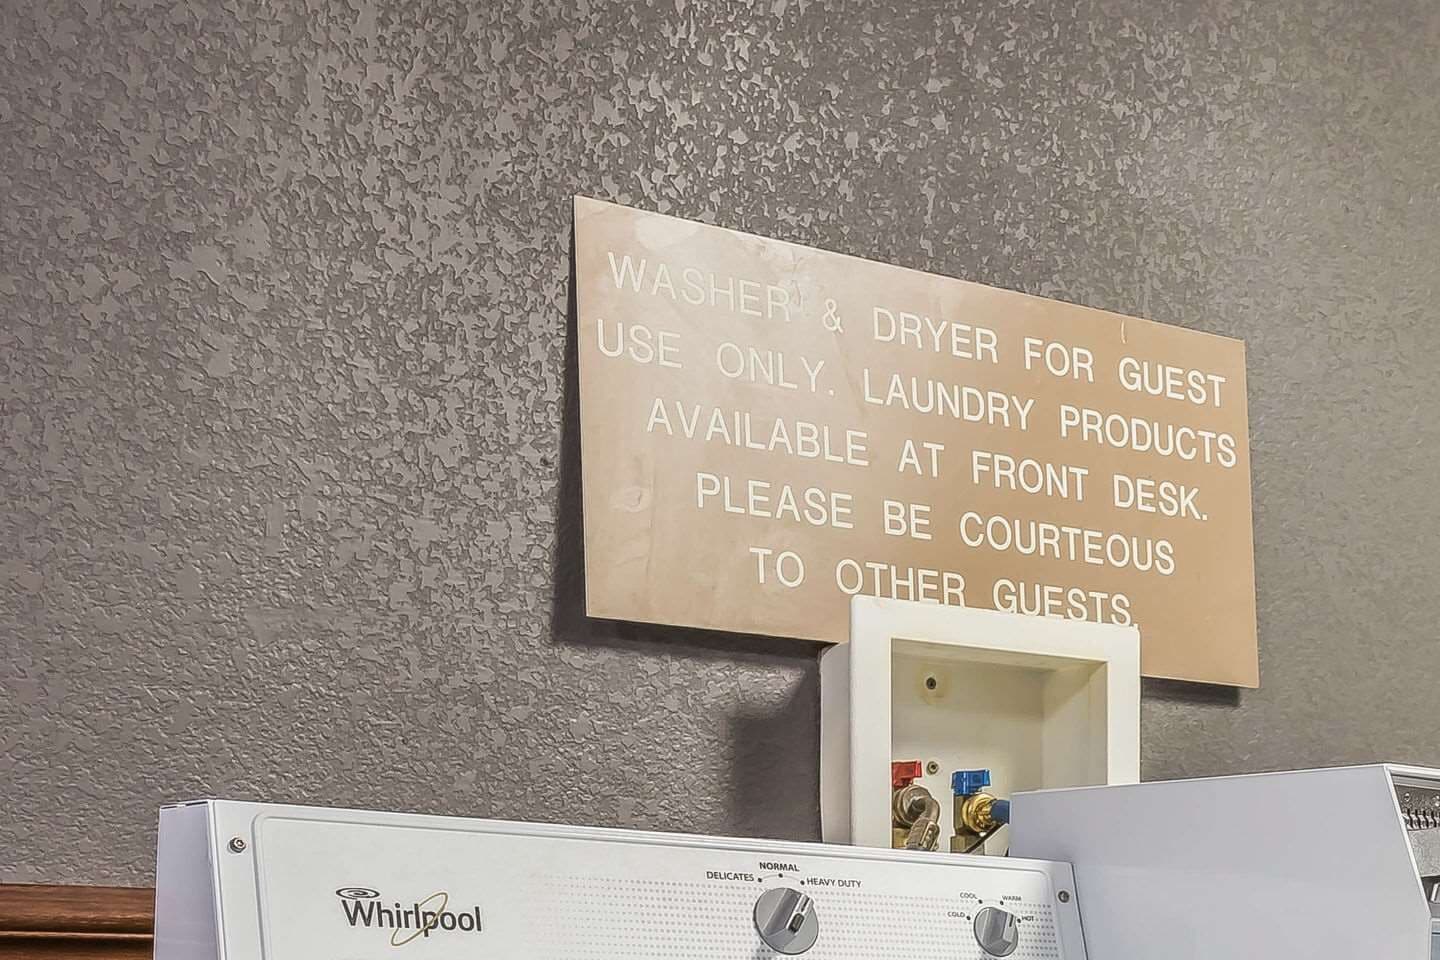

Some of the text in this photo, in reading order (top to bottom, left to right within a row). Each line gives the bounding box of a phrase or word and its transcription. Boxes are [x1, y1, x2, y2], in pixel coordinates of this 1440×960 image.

[606, 251, 1227, 408] WASHER & DRYER FOR GUEST
[596, 318, 1238, 468] USE ONLY. LAUNDRY PRODUCTS
[646, 397, 1210, 522] AVAILABLE AT FRONT DESK.
[696, 471, 1176, 576] PLEASE BE COURTEOUS
[748, 546, 805, 589] TO
[835, 558, 966, 608] OTHER
[706, 870, 755, 882] DELICATES
[759, 861, 800, 872] NORMAL
[806, 877, 862, 889] HEAVY DUTY
[341, 899, 482, 938] Whirlpool
